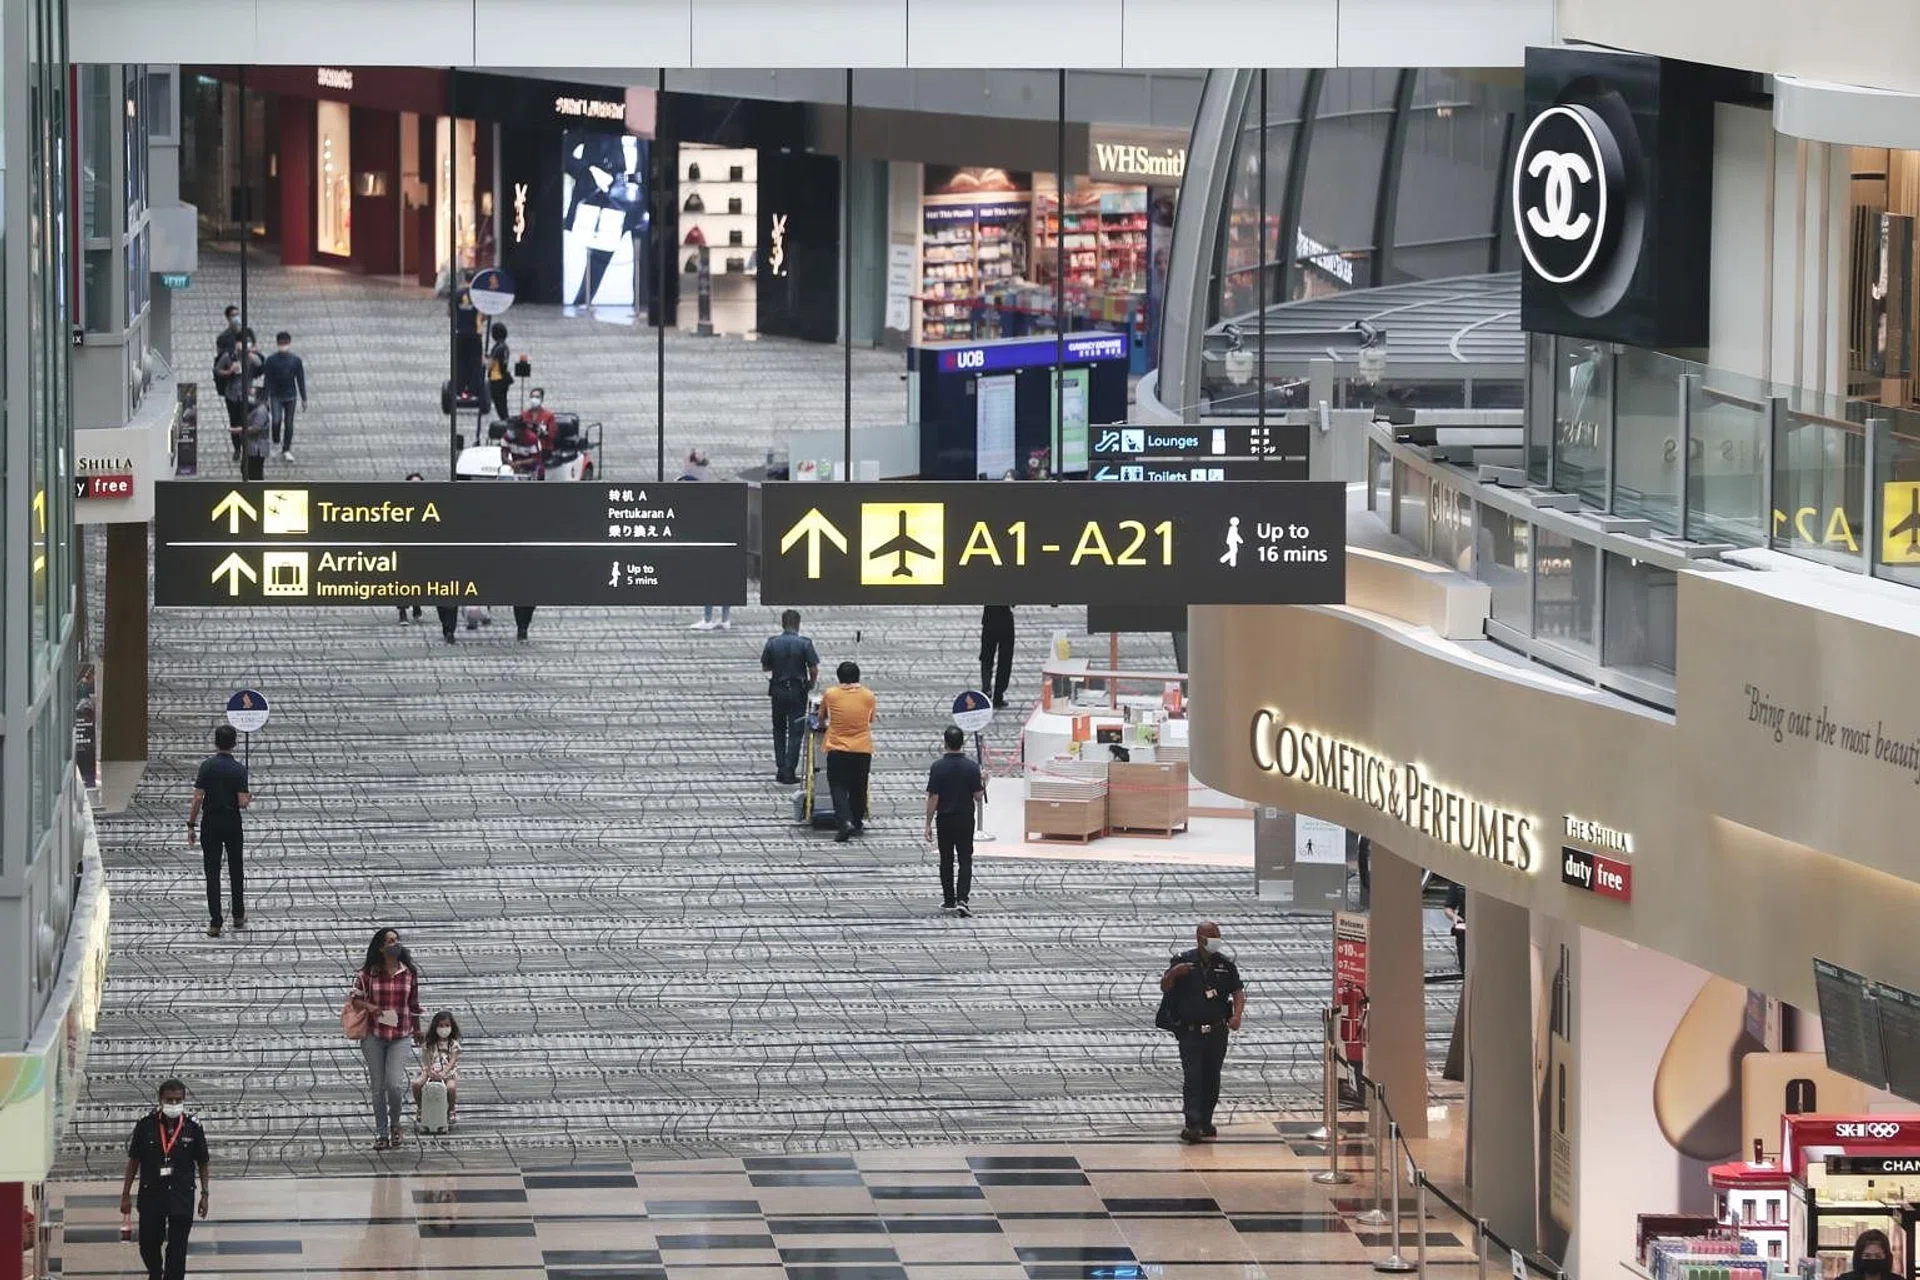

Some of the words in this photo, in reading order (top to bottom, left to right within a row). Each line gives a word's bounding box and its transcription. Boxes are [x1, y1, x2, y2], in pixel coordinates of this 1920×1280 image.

[957, 350, 985, 368] UOB
[1147, 434, 1199, 451] Lounges
[79, 457, 133, 469] SHILLA
[95, 479, 128, 492] free
[639, 490, 648, 501] A
[318, 501, 415, 523] Transfer
[421, 502, 441, 523] A
[608, 507, 664, 519] Pertukaran
[666, 508, 675, 519] A
[662, 525, 672, 537] A
[1257, 523, 1284, 543] Up
[1288, 523, 1310, 539] to
[958, 520, 1026, 566] A1
[1070, 519, 1173, 566] A21
[317, 550, 397, 572] Arrival
[1257, 545, 1279, 562] 16
[1283, 545, 1328, 562] mins
[627, 564, 641, 575] Up
[643, 564, 654, 574] to
[627, 576, 634, 585] 5
[635, 576, 658, 585] mins
[317, 581, 421, 600] Immigration
[427, 581, 459, 596] Hall
[465, 581, 478, 596] A
[1787, 711, 1812, 739] out
[1815, 705, 1837, 746] the
[1841, 725, 1871, 756] most
[1562, 815, 1585, 840] THE
[1588, 822, 1628, 853] SHILLA
[1565, 854, 1592, 887] duty
[1597, 863, 1623, 891] free
[1341, 919, 1364, 929] Welcome
